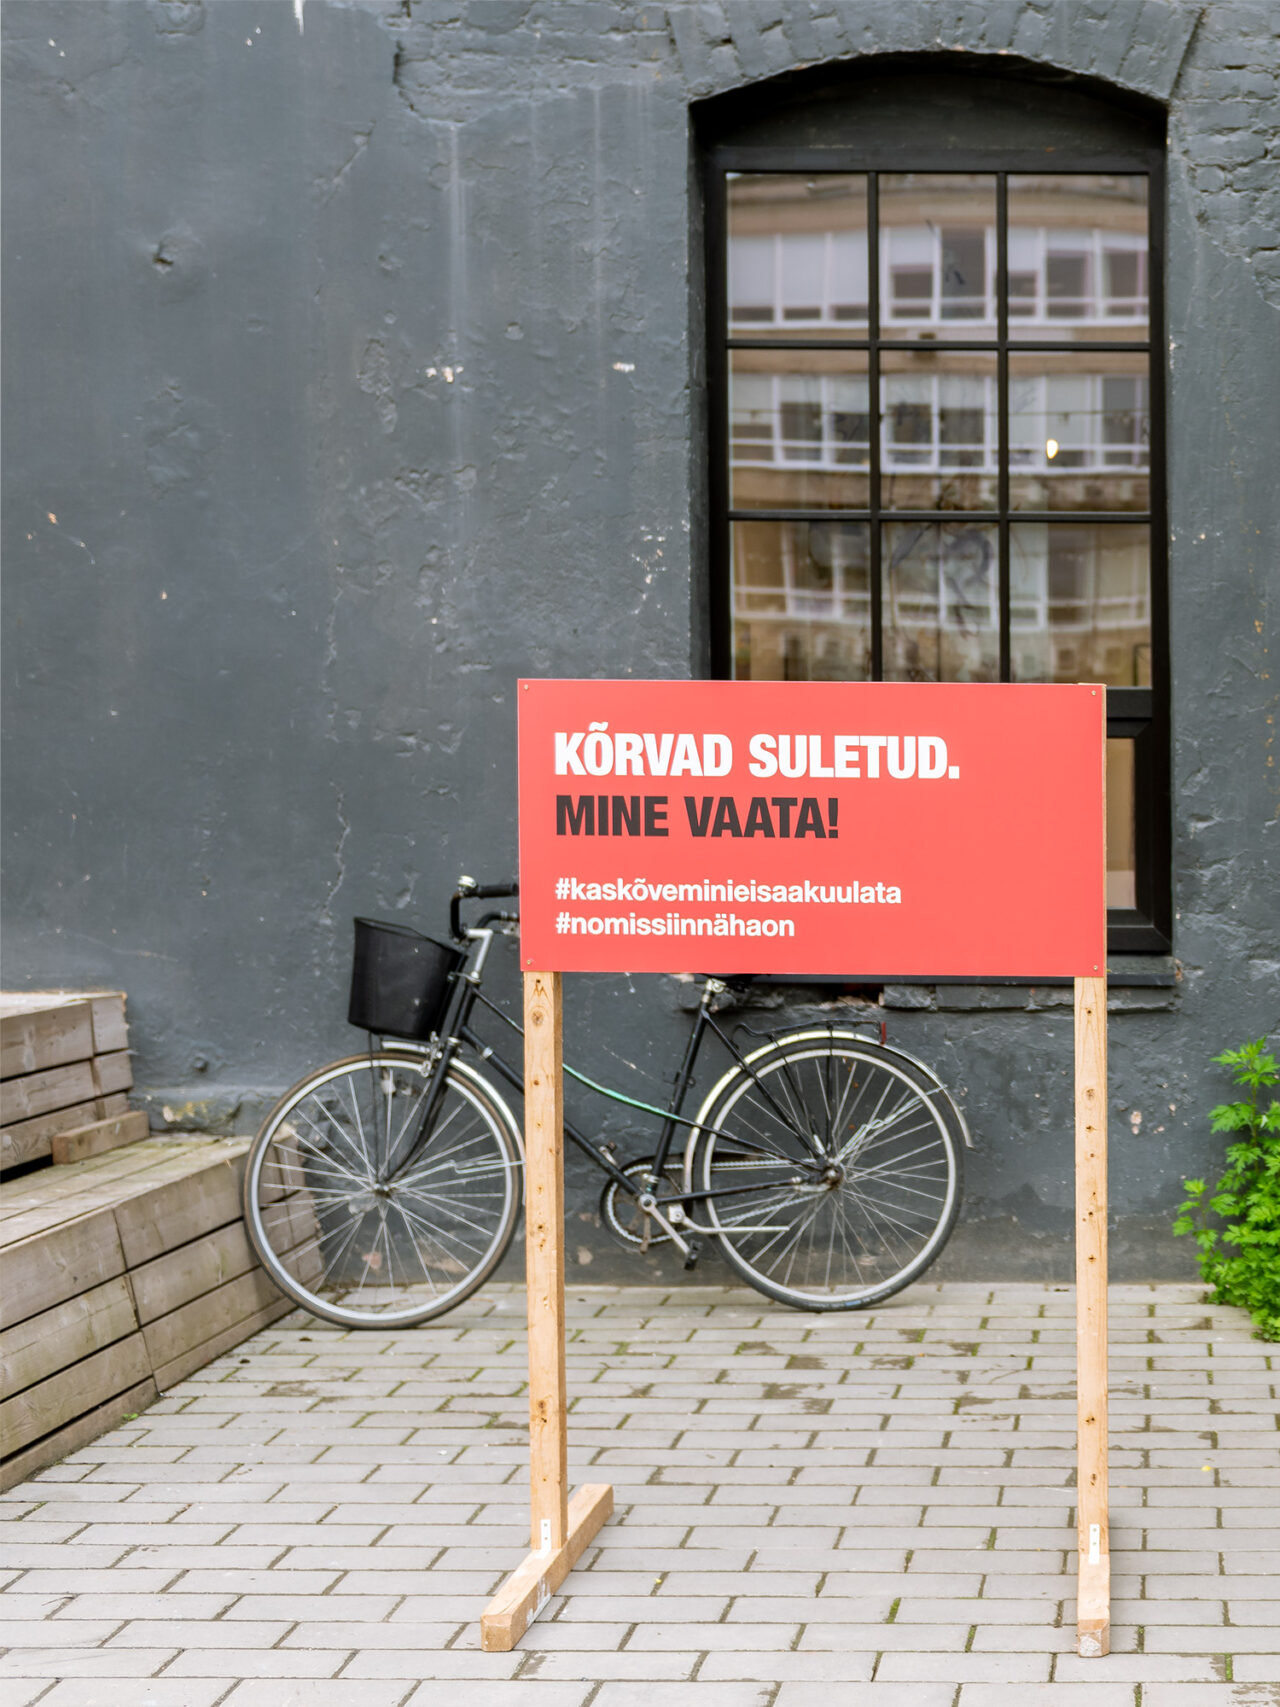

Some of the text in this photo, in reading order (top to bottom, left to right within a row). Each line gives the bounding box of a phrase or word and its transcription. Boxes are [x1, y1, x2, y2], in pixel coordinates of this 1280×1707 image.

[555, 722, 960, 779] KÕRVAD SULETUD.
[556, 795, 839, 838] MINE VAATA!
[555, 878, 901, 903] #kaskõveminieisaakuulata
[555, 912, 795, 936] #nomissiinnähaon
